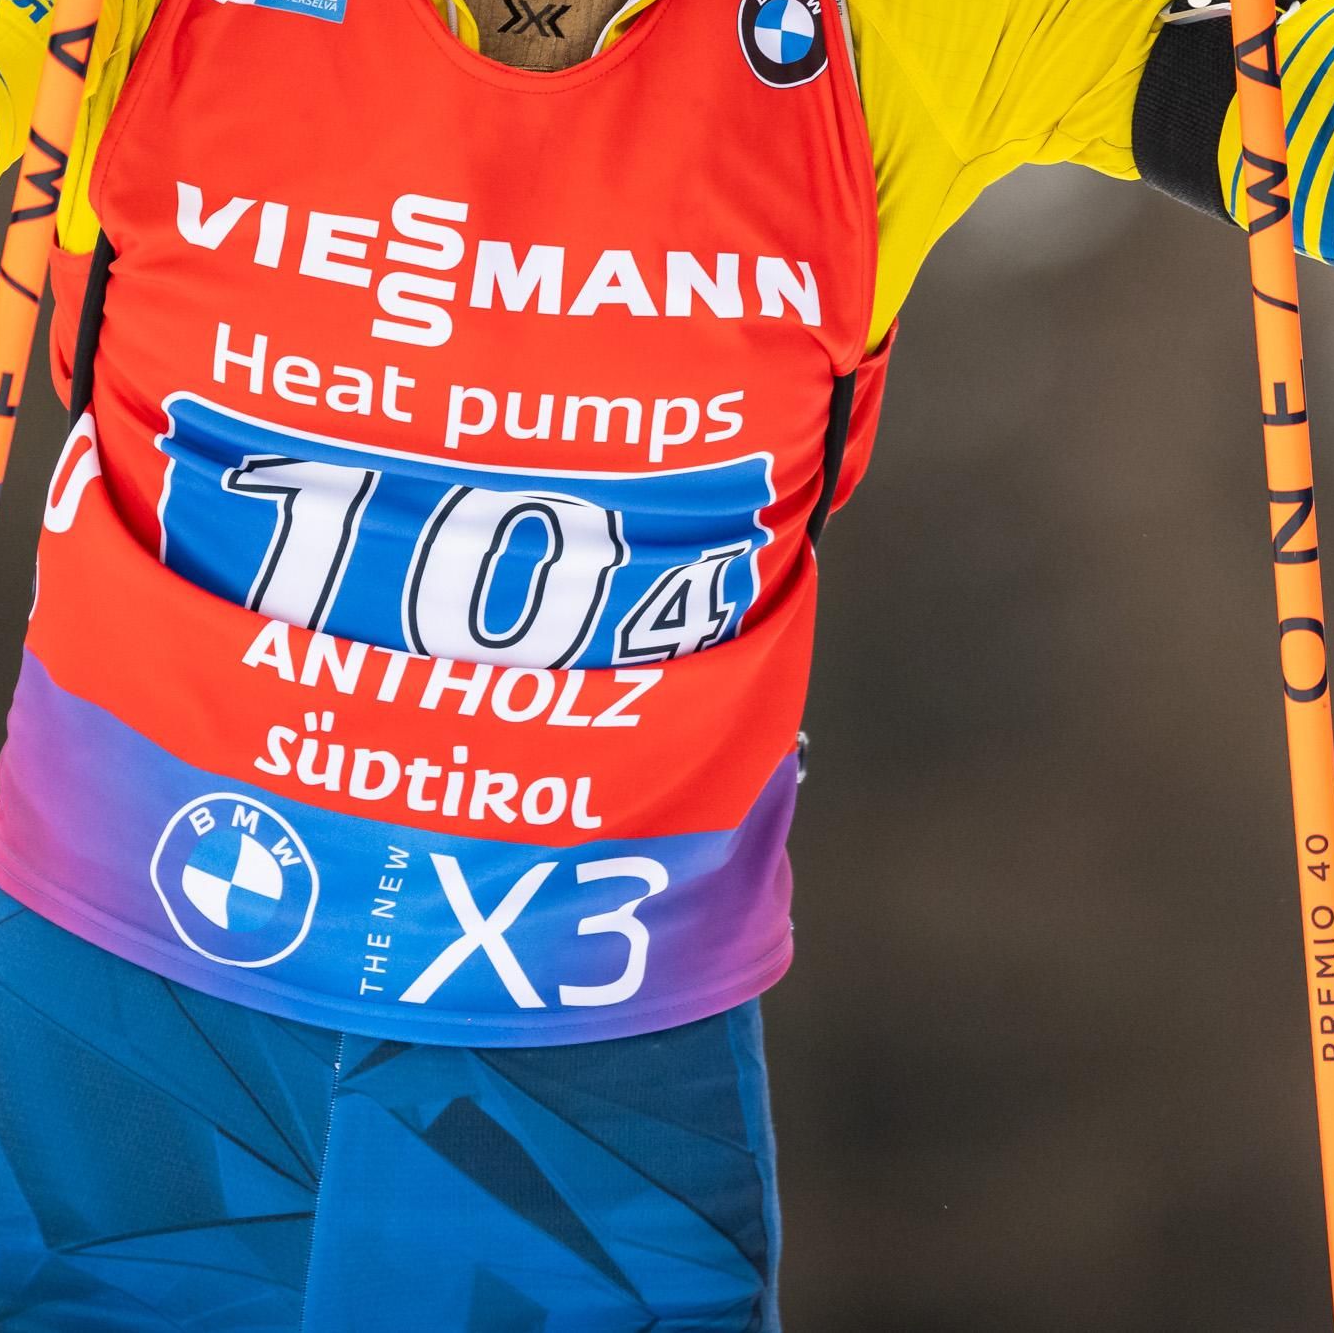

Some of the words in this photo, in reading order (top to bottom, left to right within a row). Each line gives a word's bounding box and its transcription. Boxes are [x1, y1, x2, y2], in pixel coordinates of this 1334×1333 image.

[175, 180, 823, 348] VIESSMANN
[213, 322, 418, 424] Heat
[444, 384, 745, 463] pumps
[241, 619, 663, 728] ANTHOLZ
[188, 803, 302, 867] BMW
[1304, 832, 1331, 883] 40
[371, 844, 410, 920] NEW
[359, 932, 392, 996] THE
[398, 853, 670, 1008] X3
